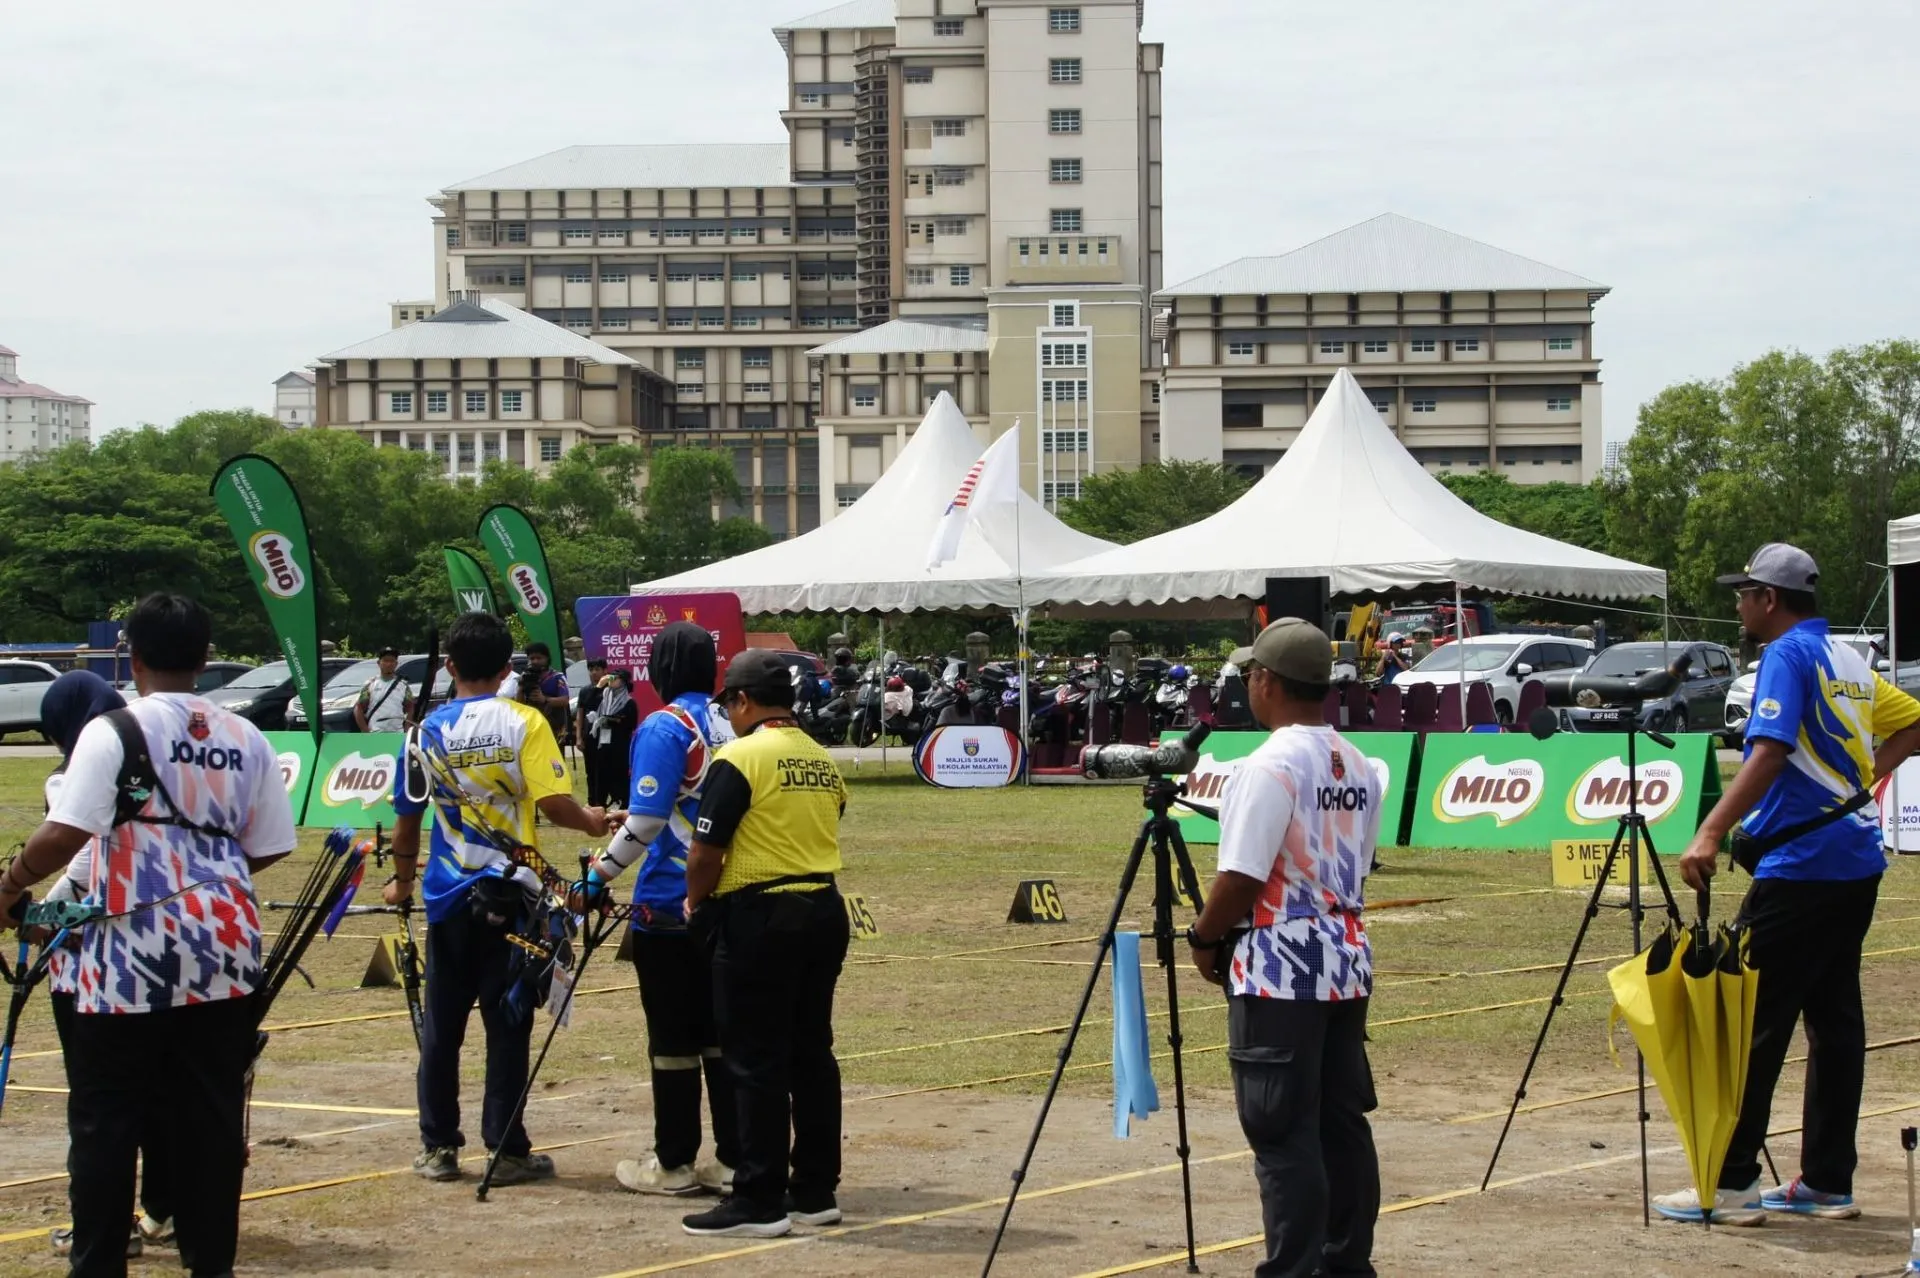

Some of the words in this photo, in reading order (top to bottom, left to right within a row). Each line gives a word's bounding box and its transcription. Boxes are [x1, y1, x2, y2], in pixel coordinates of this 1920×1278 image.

[260, 539, 294, 591] MILO
[516, 569, 540, 609] MILO
[285, 637, 308, 690] milo.com.my
[607, 646, 624, 657] KE
[630, 645, 651, 657] KE
[169, 740, 244, 771] JOHOR
[447, 747, 515, 768] ERLIS
[333, 767, 388, 790] MILO
[780, 770, 839, 789] JUDGE
[1450, 775, 1532, 804] MILO
[1583, 777, 1670, 806] MILO
[1316, 786, 1367, 811] JOHOR
[1566, 844, 1575, 861] 3
[1579, 844, 1632, 860] METER
[1583, 863, 1618, 880] LINE
[849, 897, 877, 935] 45
[1031, 883, 1063, 921] 46
